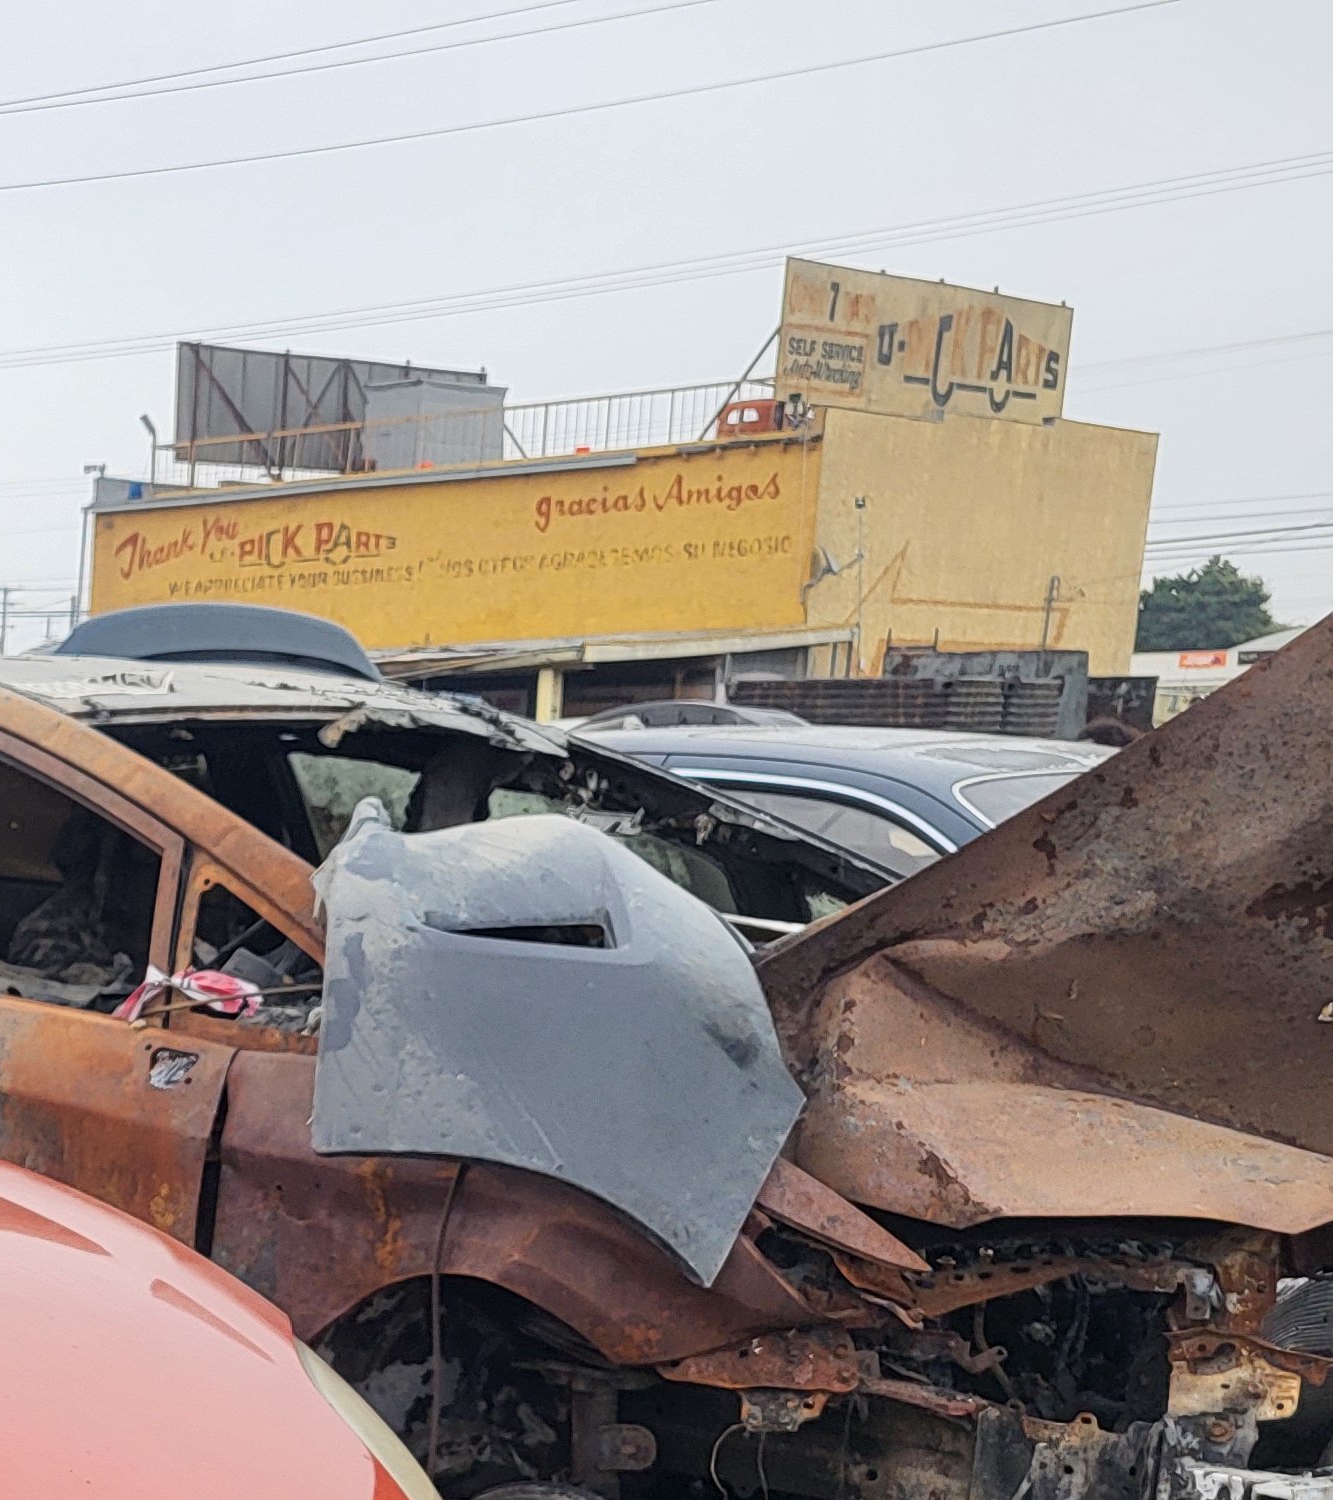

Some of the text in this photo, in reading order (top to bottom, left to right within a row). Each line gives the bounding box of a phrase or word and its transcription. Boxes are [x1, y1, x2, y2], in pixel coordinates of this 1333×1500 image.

[788, 337, 864, 364] SELF SERVICE
[976, 304, 1060, 400] PARTS
[534, 472, 780, 533] gracias Amigos
[115, 515, 239, 580] Thank You
[314, 521, 397, 564] PARTS
